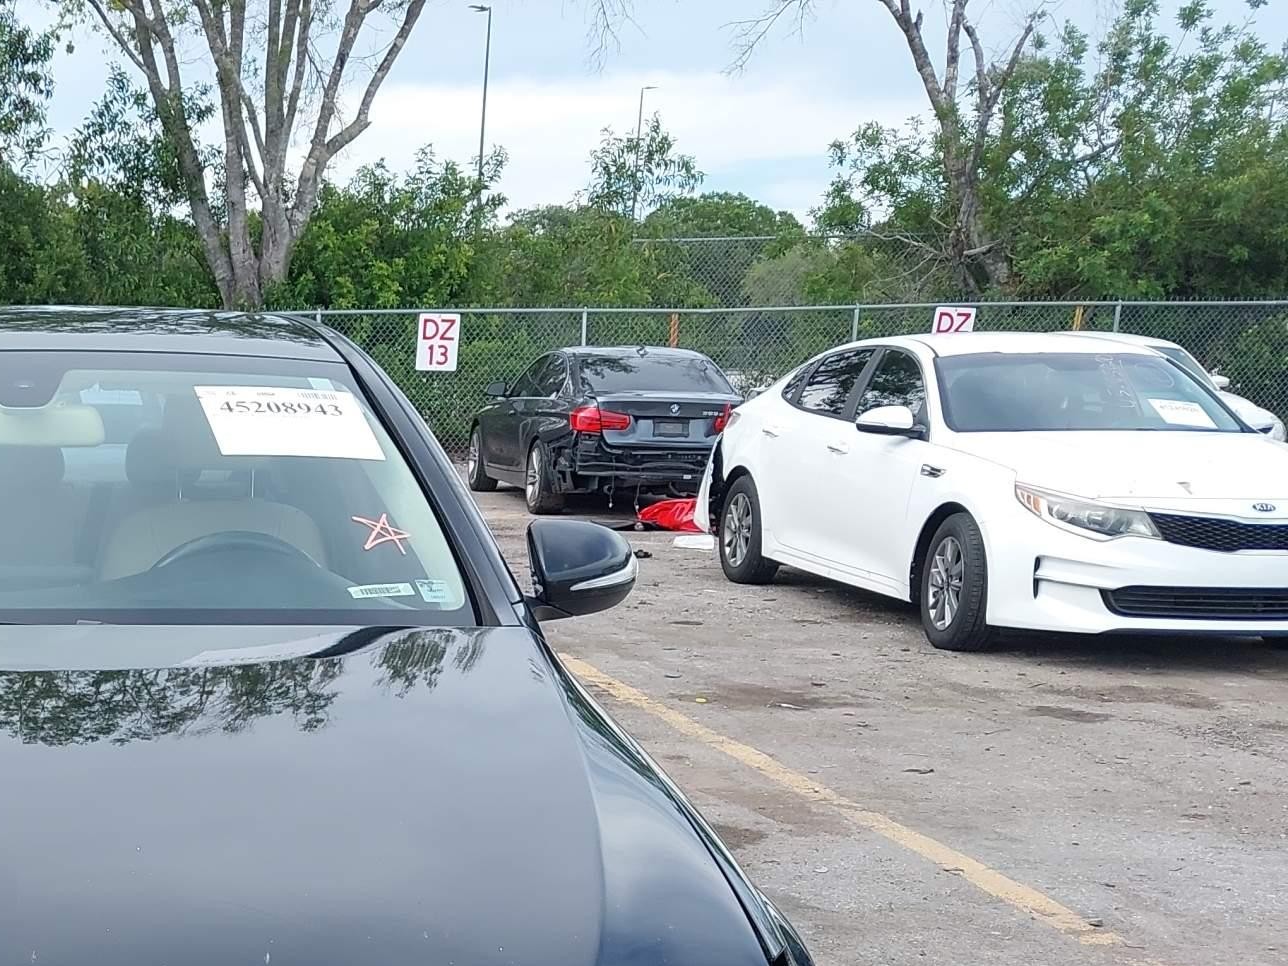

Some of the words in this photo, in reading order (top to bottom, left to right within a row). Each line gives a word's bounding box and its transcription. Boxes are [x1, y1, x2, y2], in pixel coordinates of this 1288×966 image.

[422, 318, 456, 341] DZ
[936, 311, 972, 333] DZ
[427, 344, 449, 366] 13
[219, 400, 344, 417] 45208943
